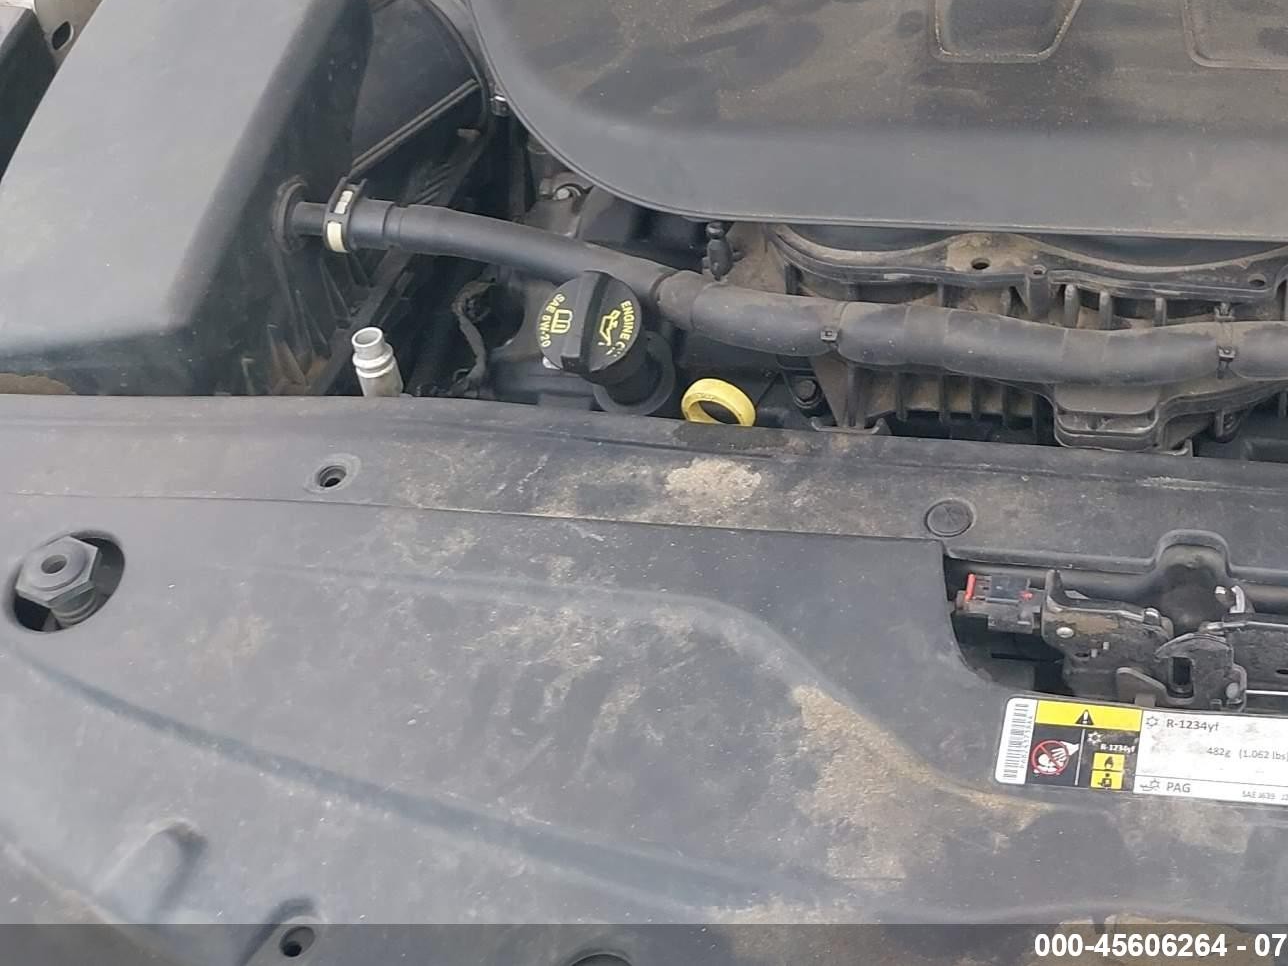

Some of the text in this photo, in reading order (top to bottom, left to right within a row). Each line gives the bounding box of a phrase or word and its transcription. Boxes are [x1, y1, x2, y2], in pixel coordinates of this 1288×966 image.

[545, 294, 565, 313] SAE
[620, 300, 635, 340] ENGINE
[1166, 719, 1219, 733] R-1234yf
[1100, 743, 1136, 754] R-1234yf
[1206, 747, 1232, 758] 482g
[1166, 781, 1191, 793] PAG
